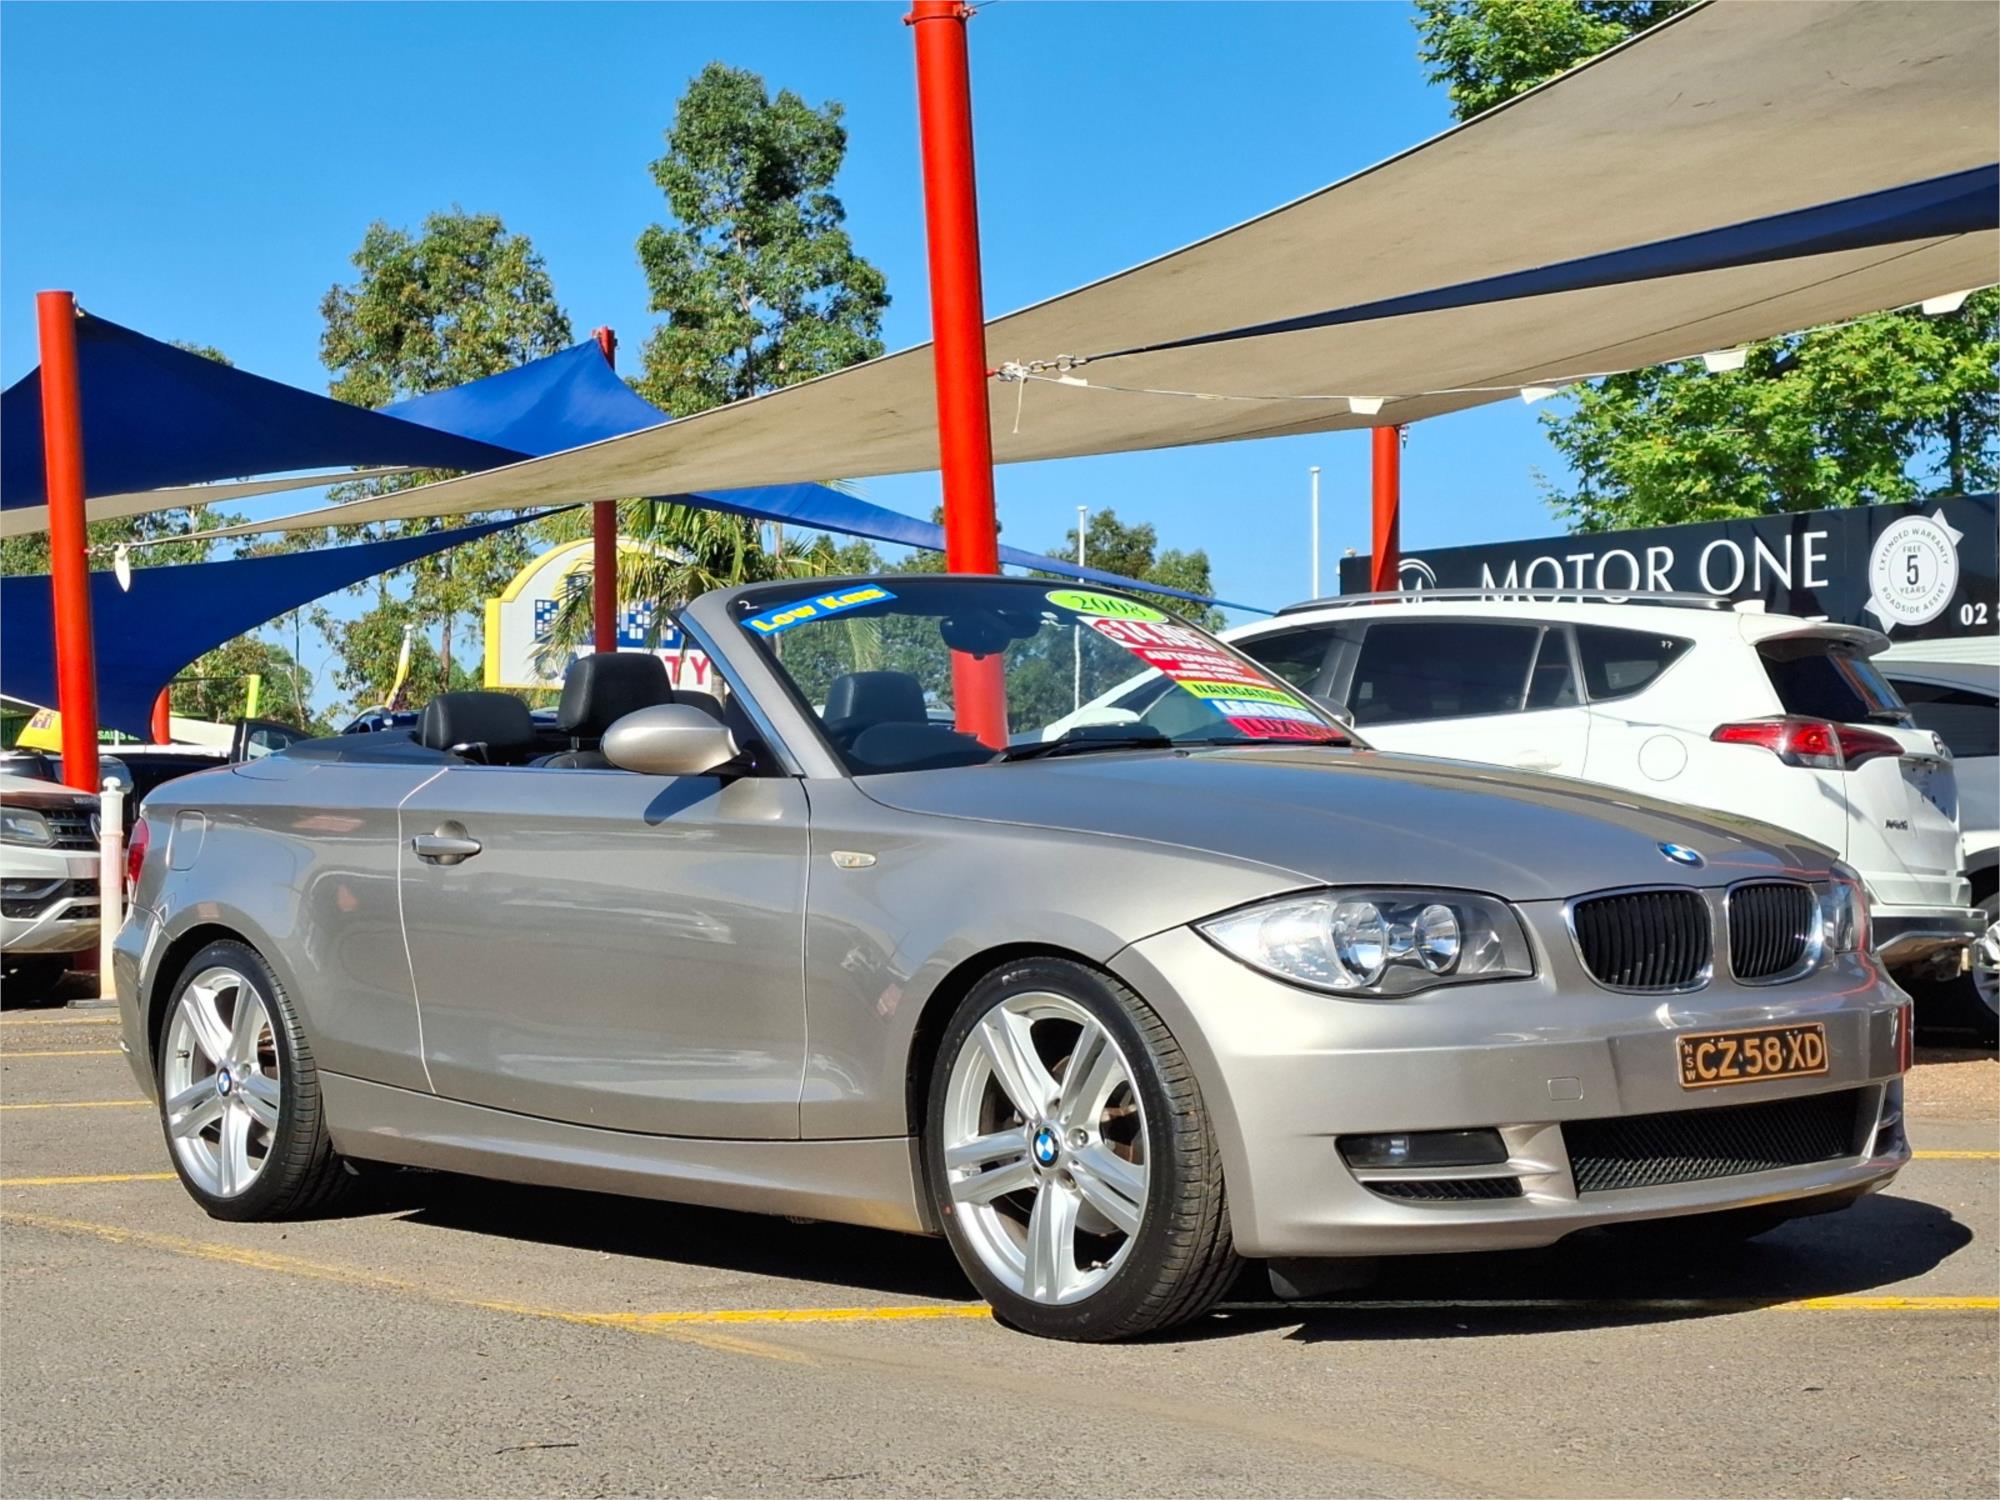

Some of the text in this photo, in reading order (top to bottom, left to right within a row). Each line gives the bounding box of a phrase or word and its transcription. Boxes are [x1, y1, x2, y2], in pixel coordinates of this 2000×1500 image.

[1879, 527, 1949, 571] EXTENDED WARRANTY
[1902, 545, 1921, 553] FREE
[1480, 530, 1830, 604] MOTOR ONE
[1906, 554, 1920, 586] 5
[1881, 582, 1947, 614] ROADSIDE ASSIST
[1900, 585, 1926, 594] YEARS
[1069, 595, 1147, 617] 2008
[1960, 602, 1988, 626] 02
